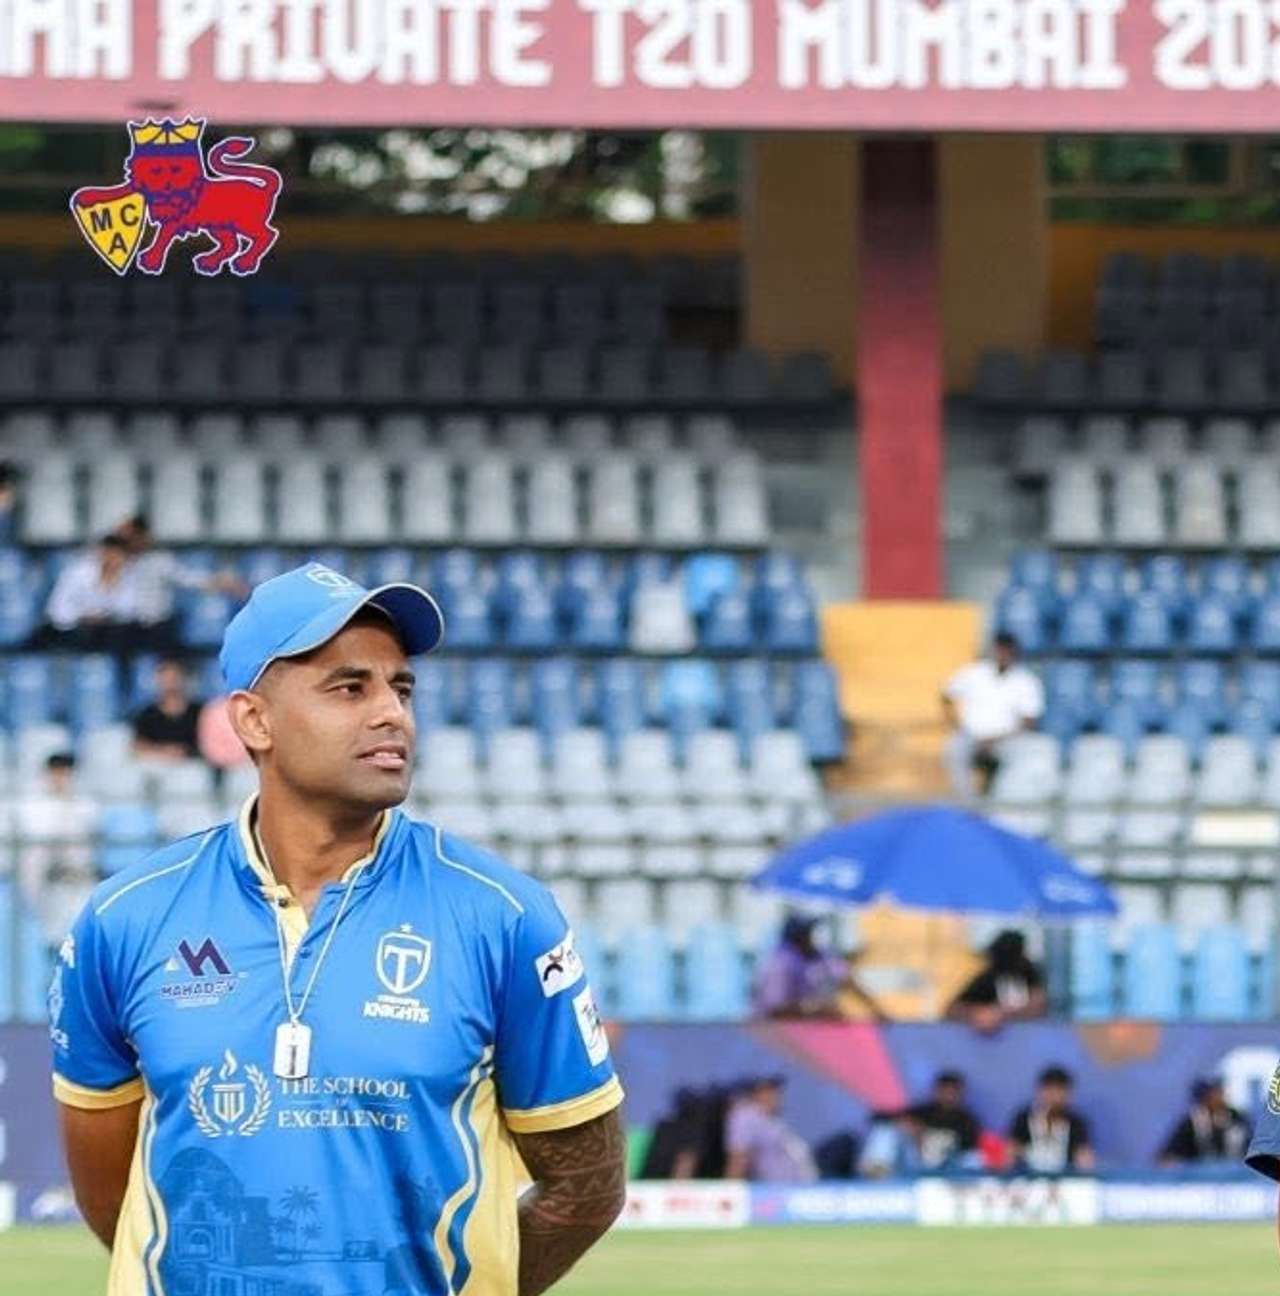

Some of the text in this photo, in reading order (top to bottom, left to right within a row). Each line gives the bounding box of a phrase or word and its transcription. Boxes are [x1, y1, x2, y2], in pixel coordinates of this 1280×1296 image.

[158, 0, 553, 86] PRIVATE
[579, 0, 753, 89] T20
[778, 0, 1128, 90] MUMBAI
[323, 1076, 412, 1100] SCHOOL
[277, 1109, 410, 1133] EXCELLENCE
